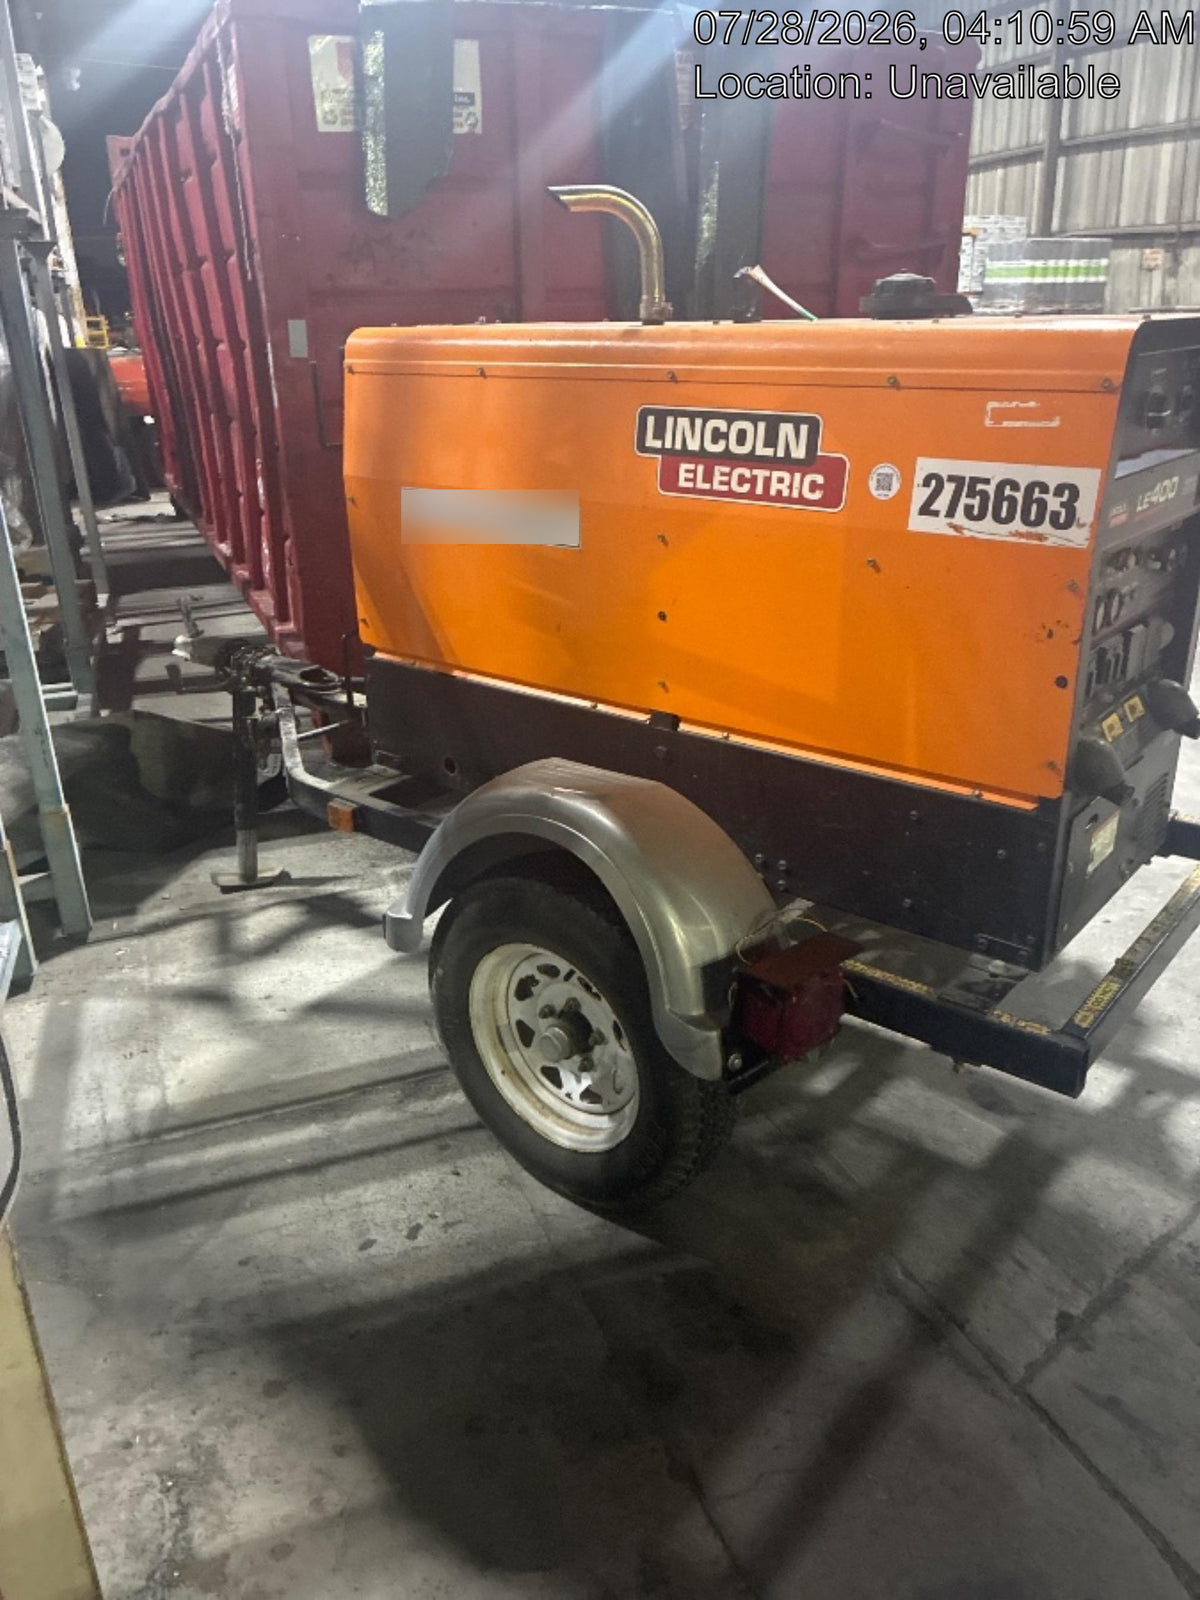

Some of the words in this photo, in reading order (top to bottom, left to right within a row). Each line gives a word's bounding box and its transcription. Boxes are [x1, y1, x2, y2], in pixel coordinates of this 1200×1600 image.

[645, 414, 809, 461] LINCOLN
[677, 463, 825, 502] ELECTRIC
[918, 472, 1081, 530] 275663
